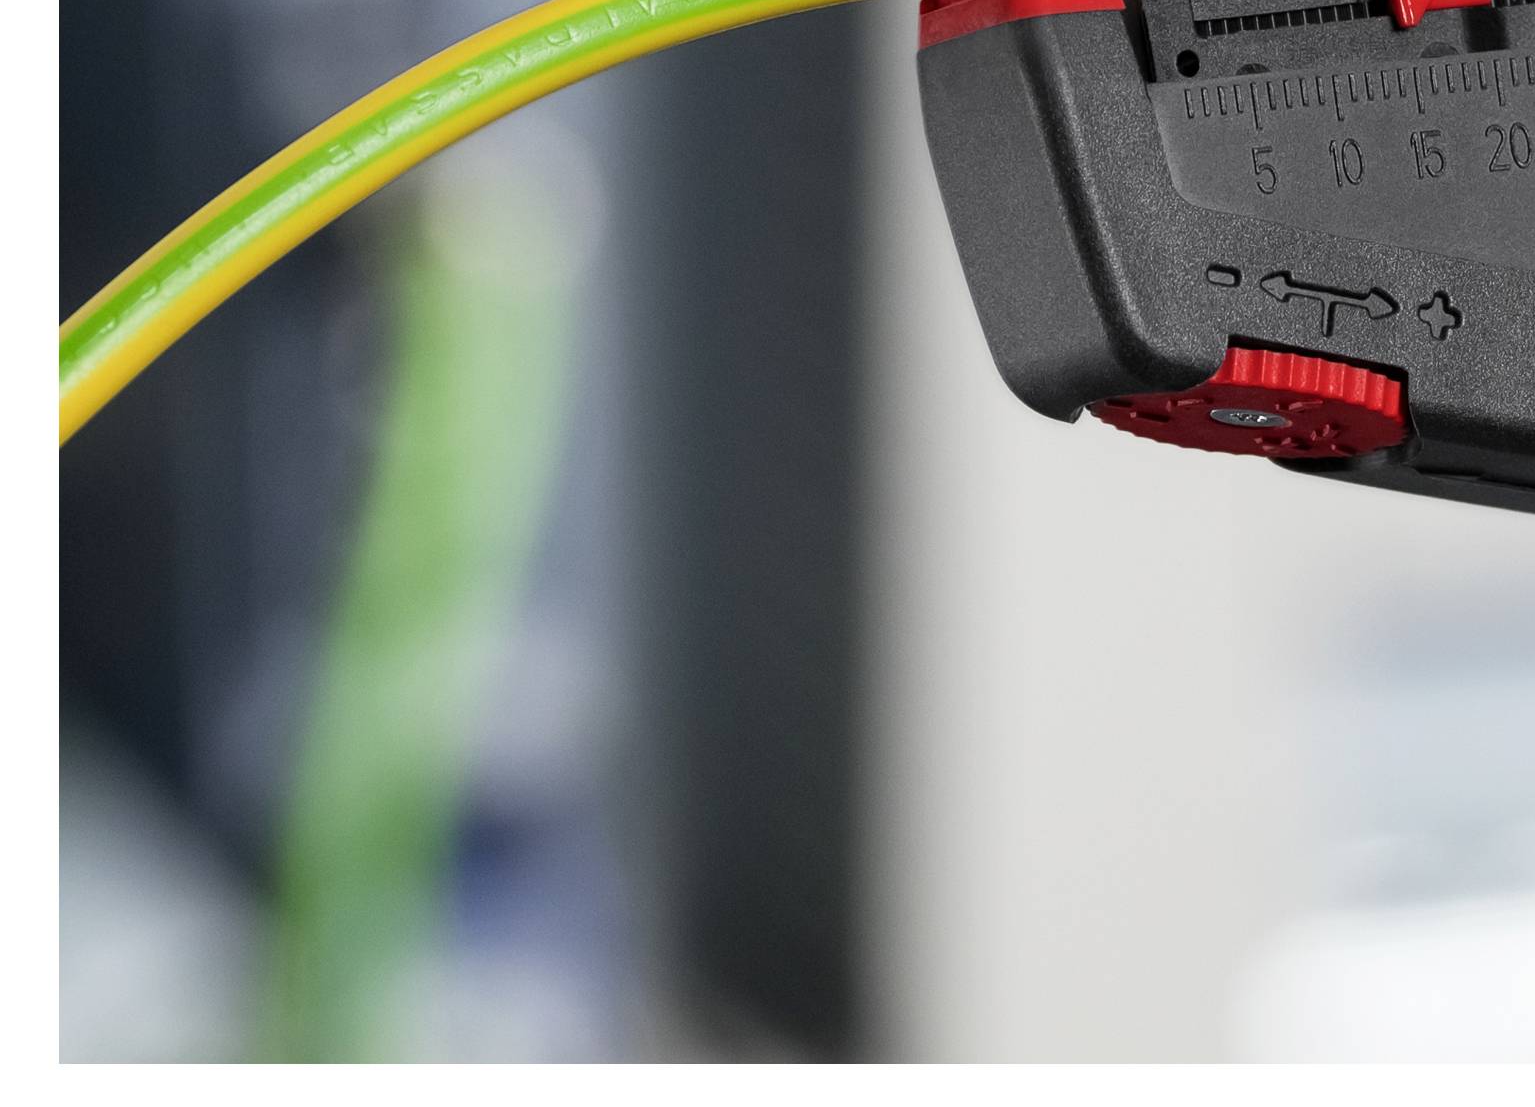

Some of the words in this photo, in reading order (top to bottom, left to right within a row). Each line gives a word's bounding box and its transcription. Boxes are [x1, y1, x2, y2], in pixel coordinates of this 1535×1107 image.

[1252, 145, 1278, 195] 5
[1329, 138, 1364, 188] 10
[1410, 129, 1446, 180] 15
[1485, 121, 1533, 173] 20
